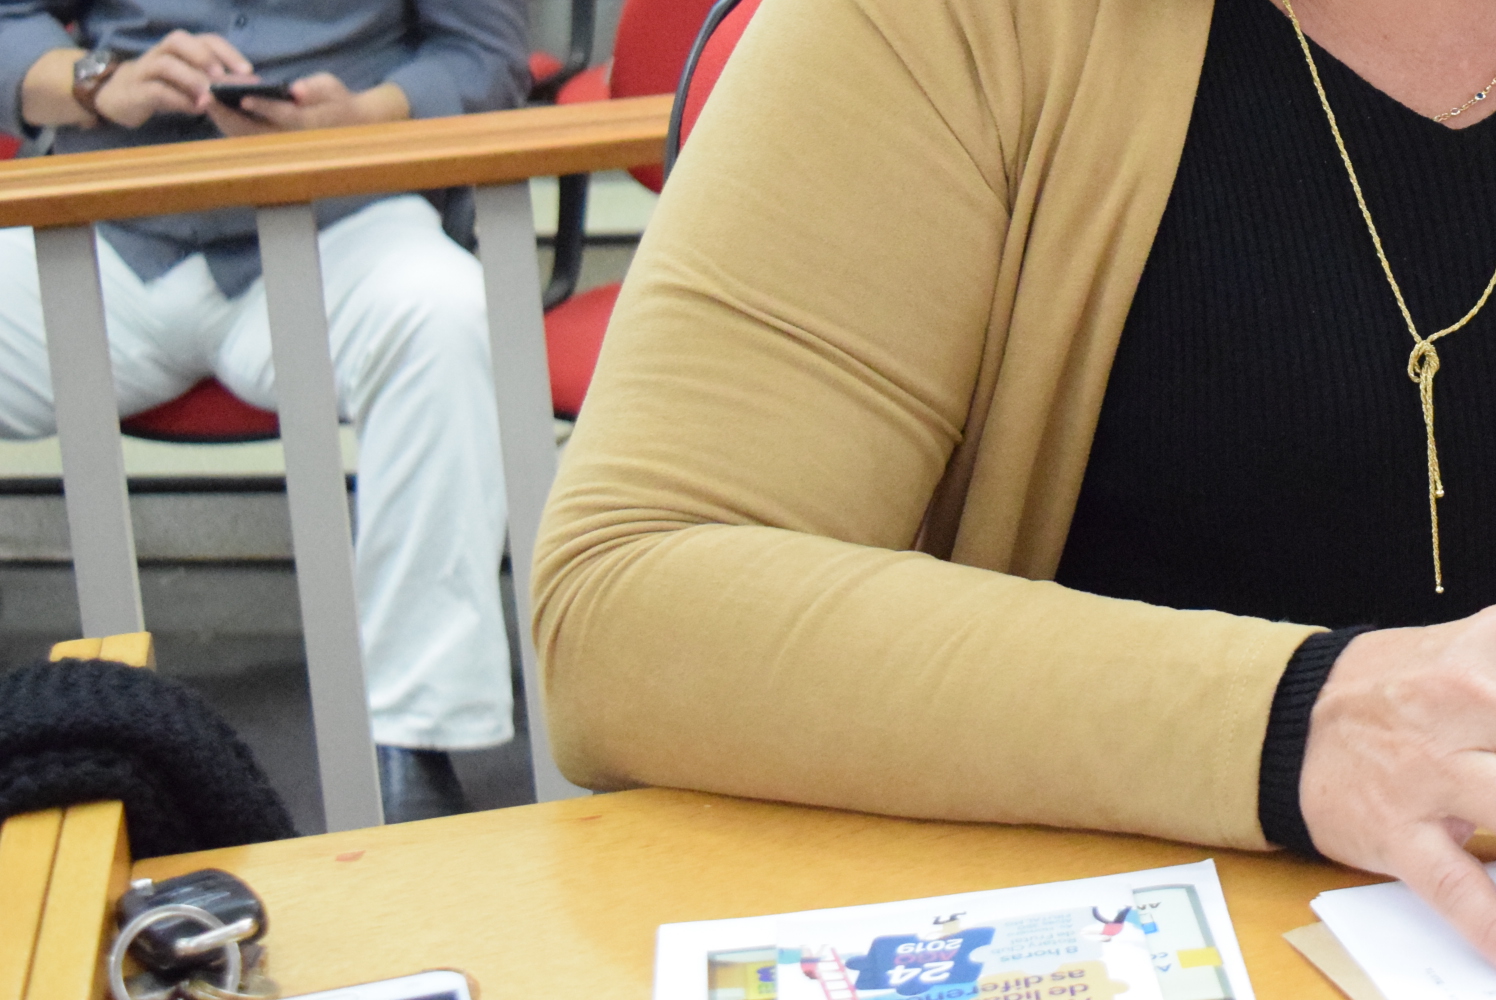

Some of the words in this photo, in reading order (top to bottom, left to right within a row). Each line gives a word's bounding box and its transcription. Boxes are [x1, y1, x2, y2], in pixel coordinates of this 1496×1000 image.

[896, 938, 964, 954] 2019
[1065, 945, 1079, 954] 8
[893, 949, 959, 965] AGO
[999, 948, 1061, 963] horas
[887, 960, 954, 985] 24
[1049, 969, 1086, 980] as
[1048, 983, 1089, 997] de
